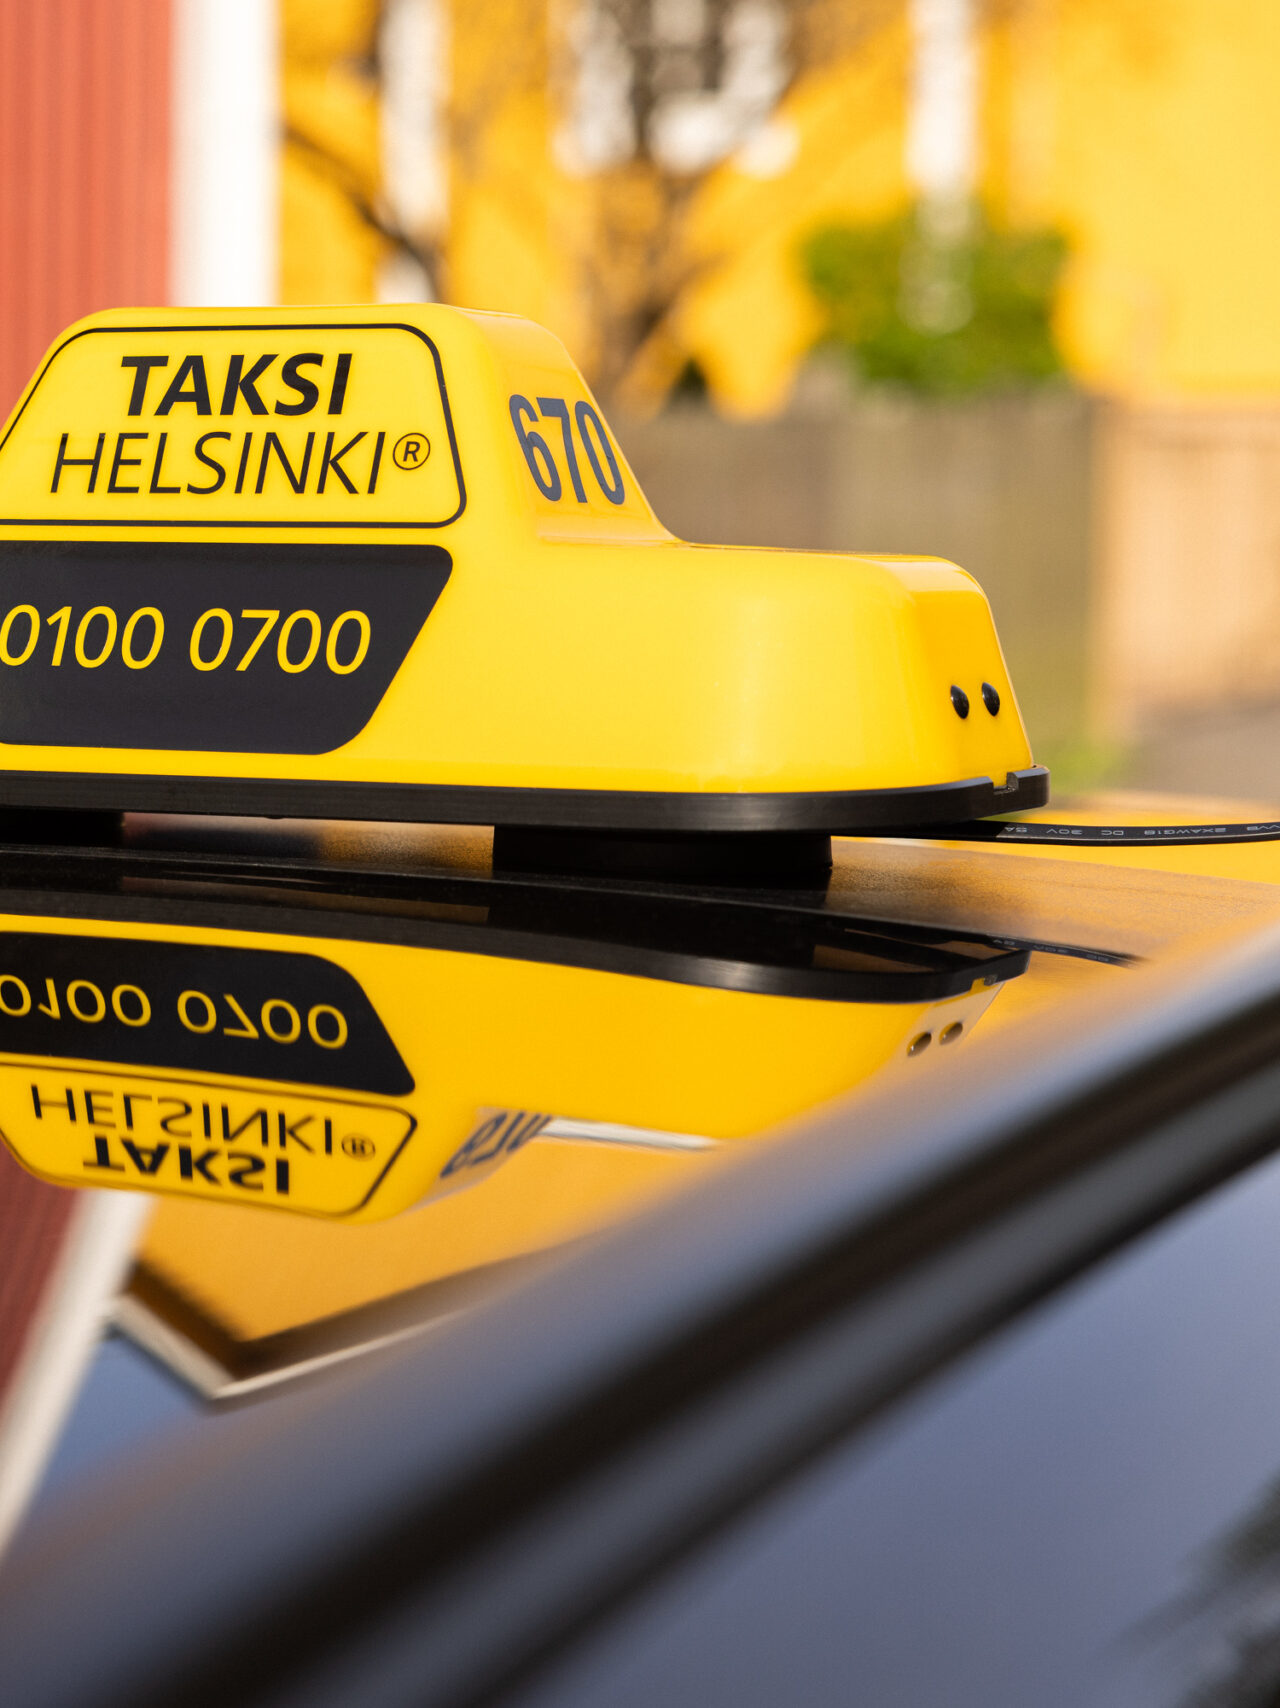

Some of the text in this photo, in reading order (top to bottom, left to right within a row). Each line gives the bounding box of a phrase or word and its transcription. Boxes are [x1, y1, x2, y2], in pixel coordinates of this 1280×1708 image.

[120, 353, 353, 417] TAKSI
[509, 394, 626, 506] 670
[189, 608, 372, 676] 0700
